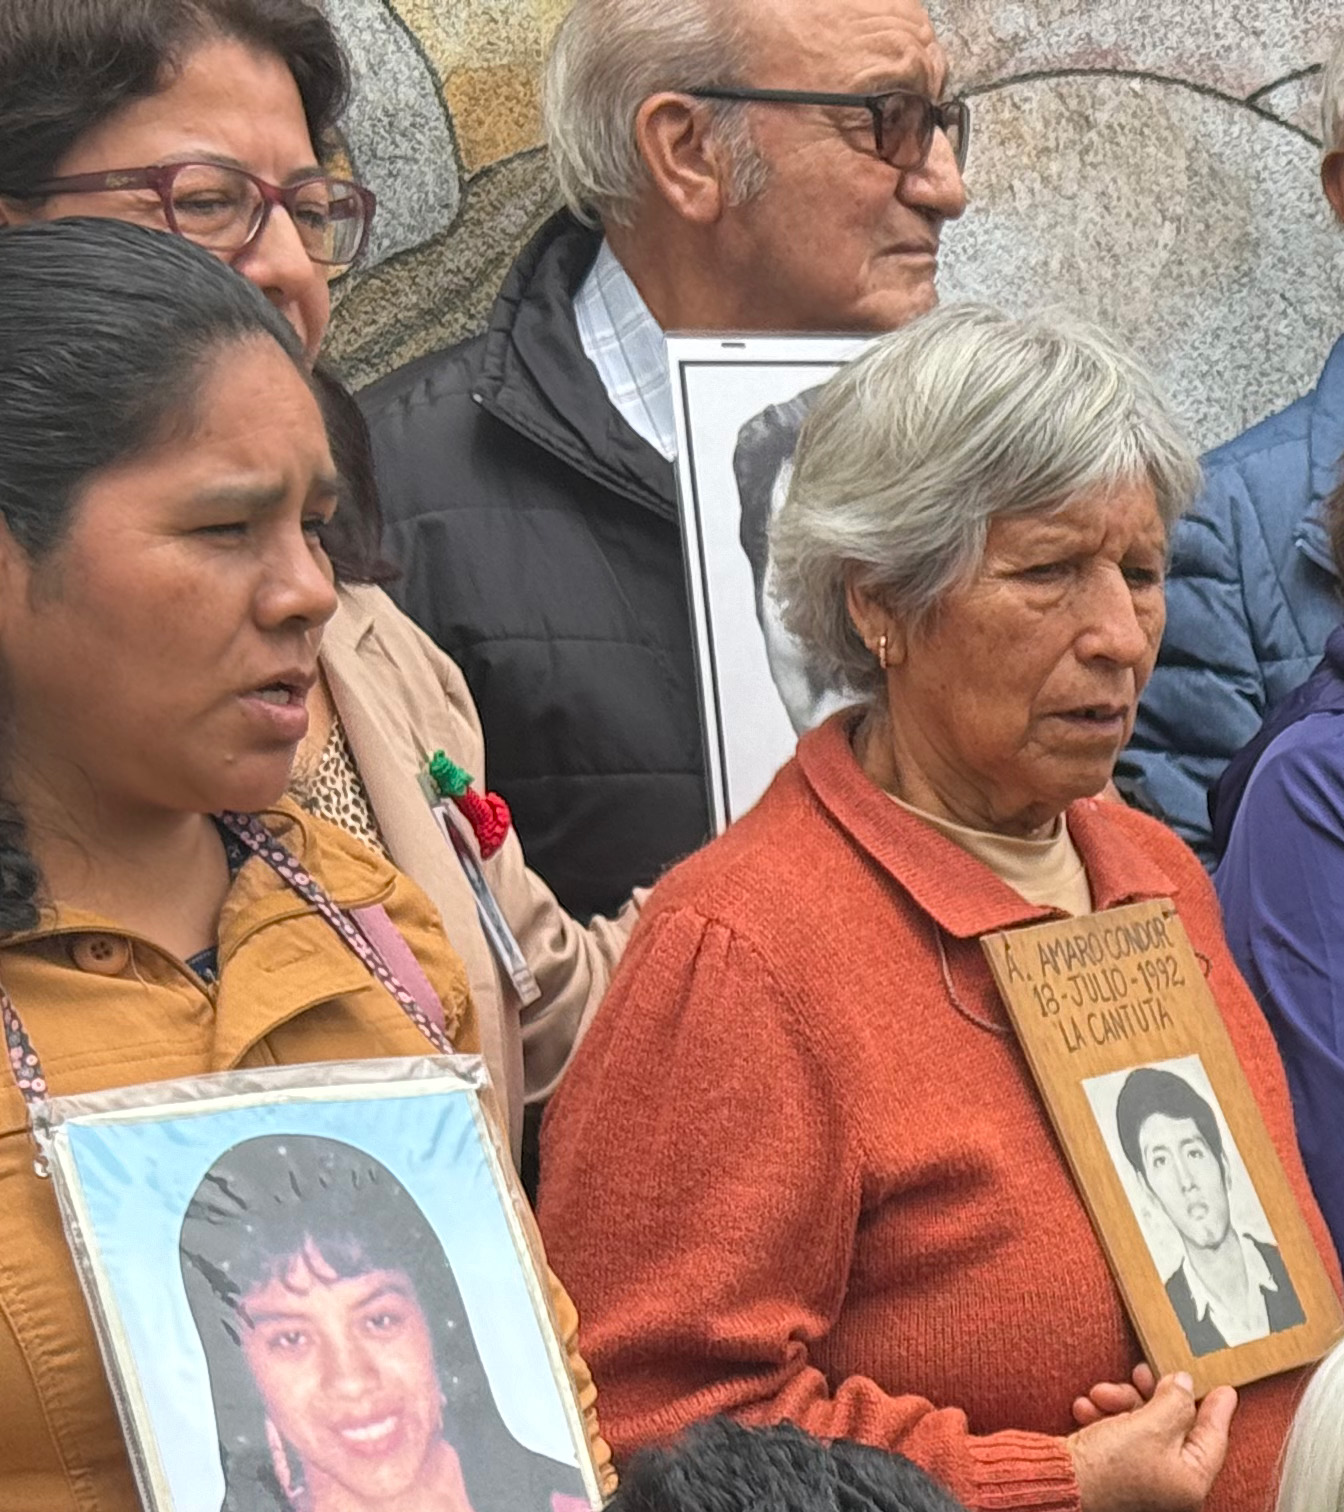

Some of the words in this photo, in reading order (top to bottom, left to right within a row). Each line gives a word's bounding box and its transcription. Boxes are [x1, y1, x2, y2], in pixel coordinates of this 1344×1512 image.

[1036, 931, 1104, 978] AMARO
[1104, 917, 1174, 961] CONDOR
[1057, 1016, 1087, 1054] LA
[1087, 998, 1175, 1046] CANTUTA
